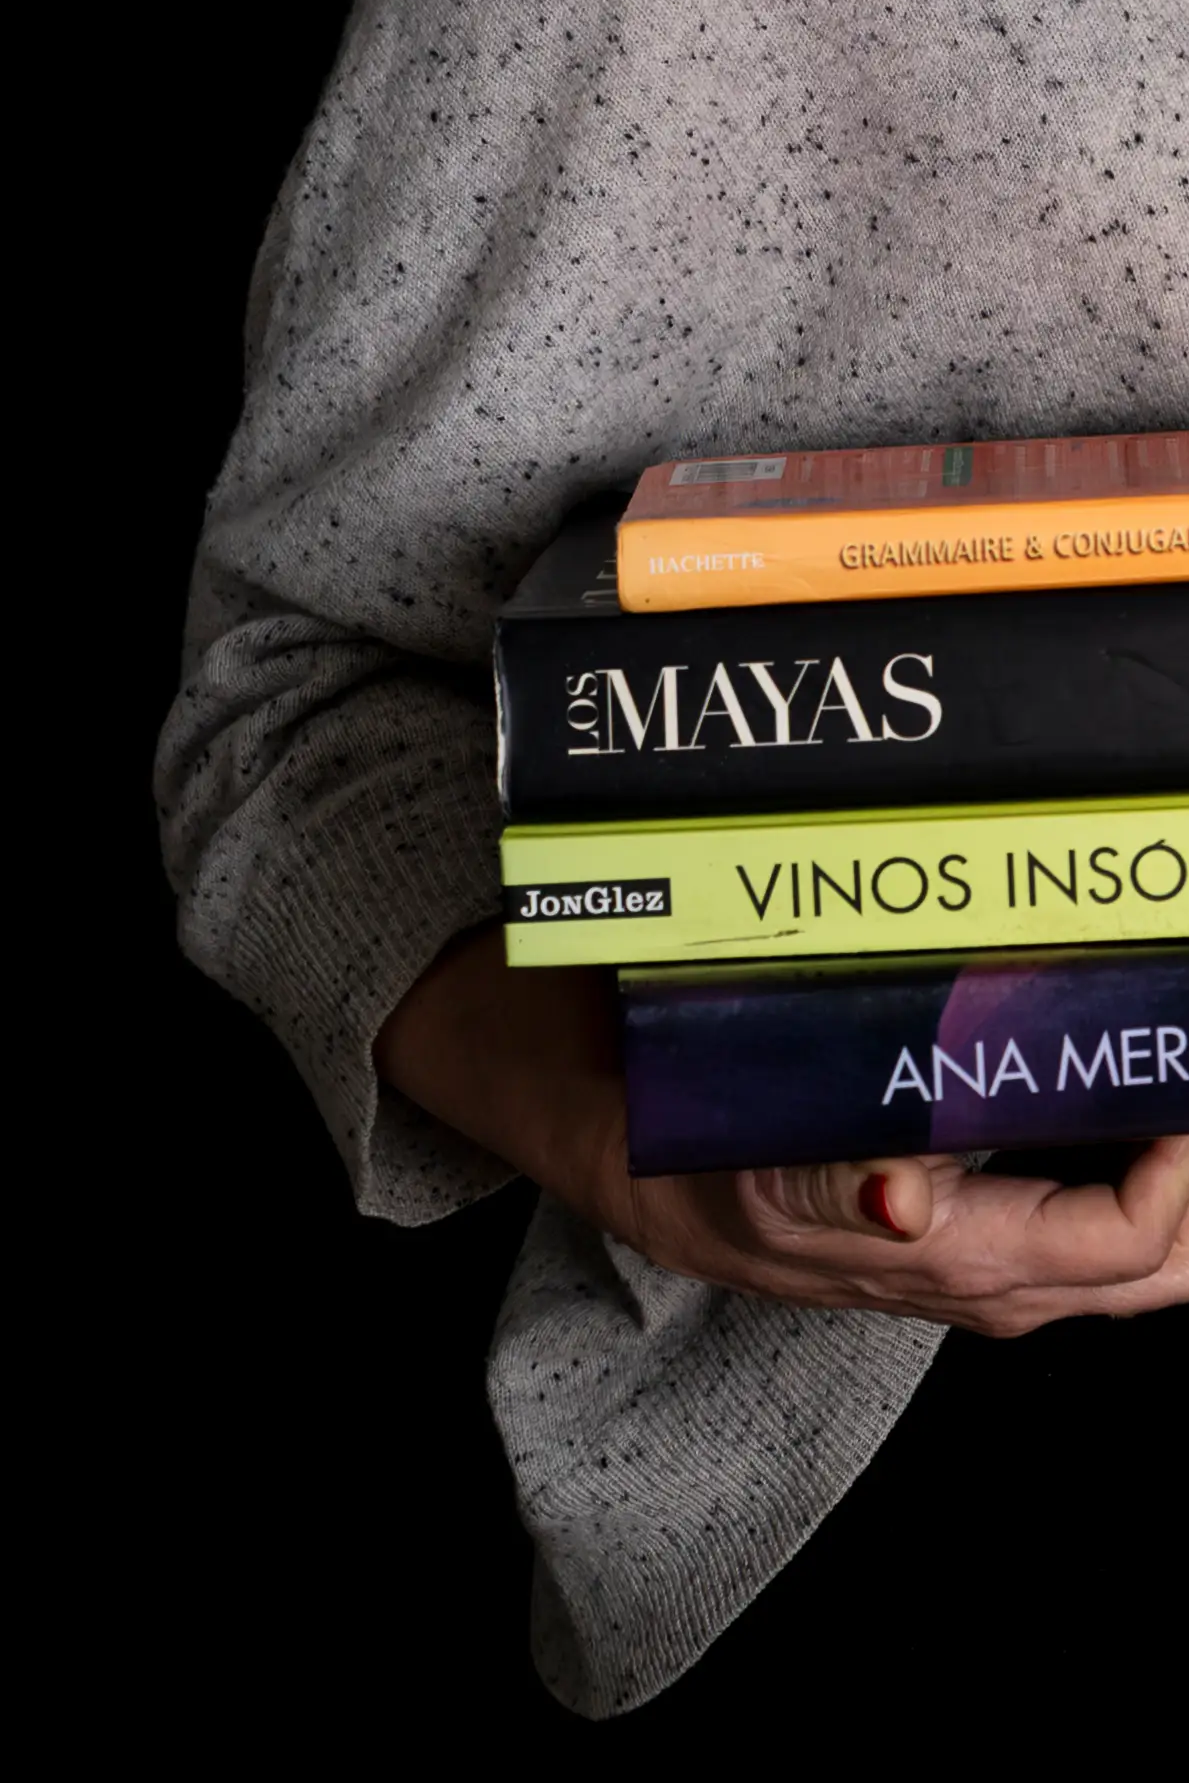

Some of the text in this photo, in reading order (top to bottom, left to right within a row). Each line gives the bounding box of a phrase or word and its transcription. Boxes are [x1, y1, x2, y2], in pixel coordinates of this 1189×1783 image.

[649, 552, 766, 575] HACHETTE
[839, 537, 1015, 570] GRAMMAIRE
[1024, 535, 1043, 559] &
[567, 672, 599, 756] LOS
[597, 653, 943, 754] MAYAS
[736, 854, 973, 920] VINOS
[881, 1038, 1039, 1106] ANA
